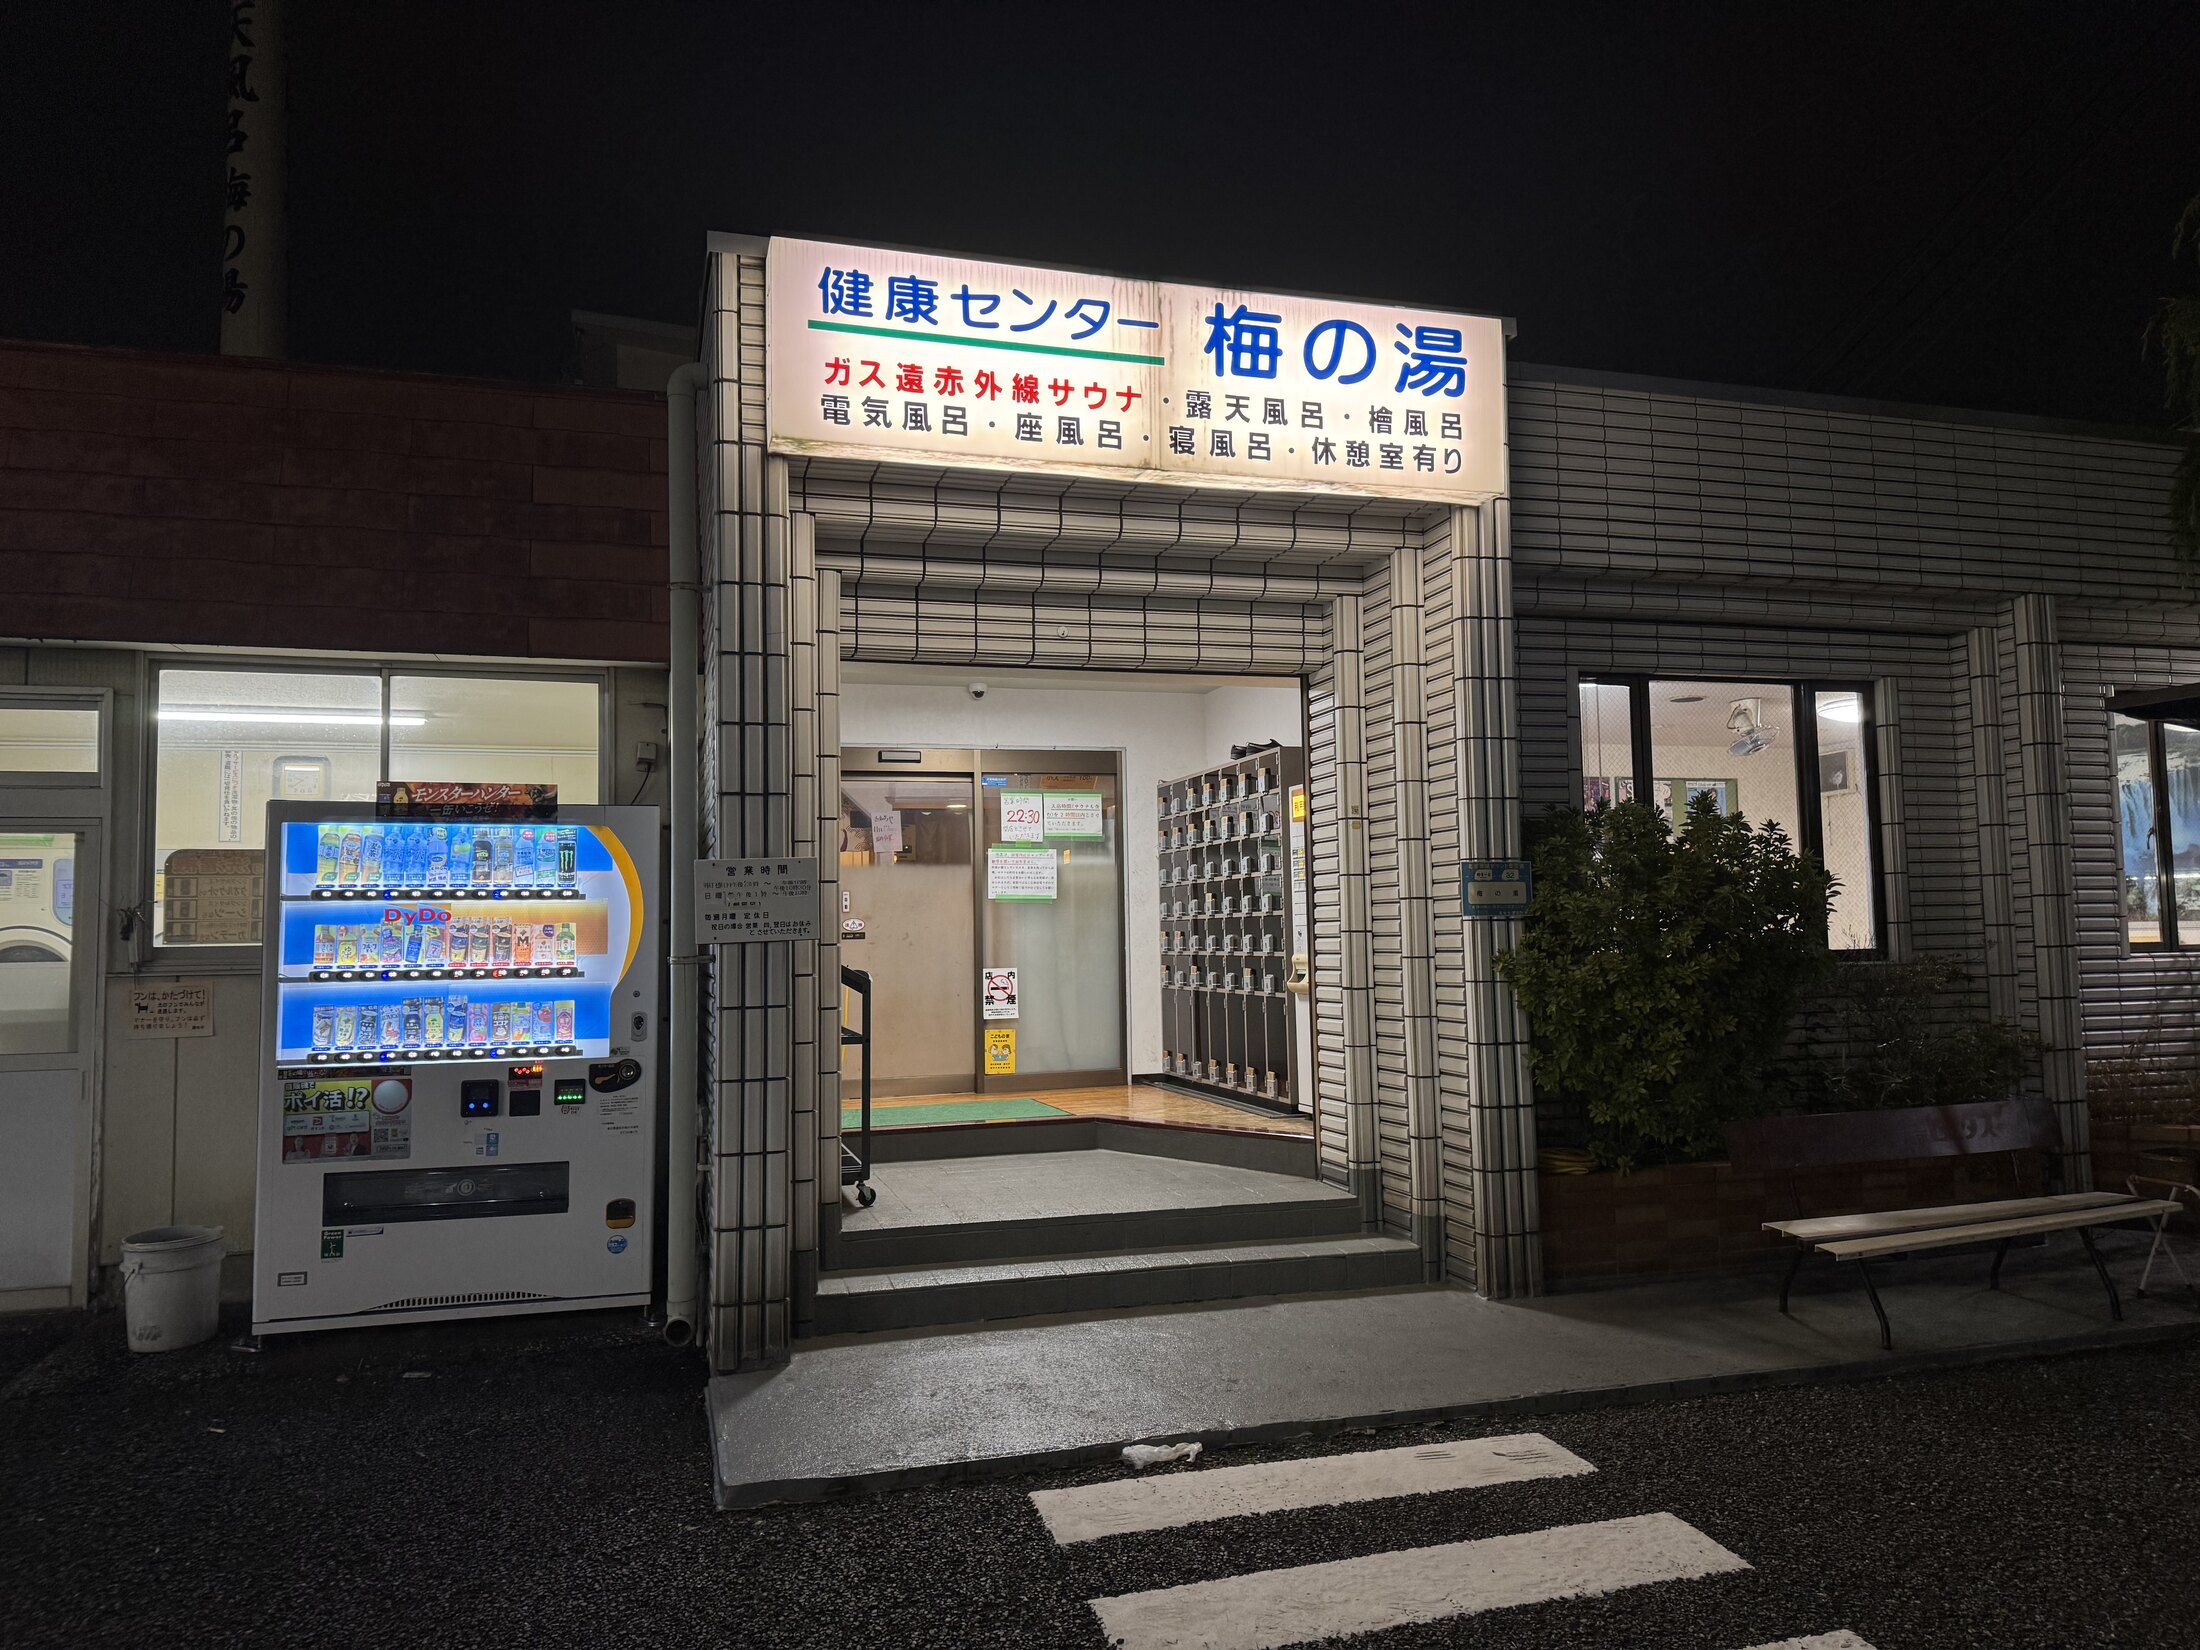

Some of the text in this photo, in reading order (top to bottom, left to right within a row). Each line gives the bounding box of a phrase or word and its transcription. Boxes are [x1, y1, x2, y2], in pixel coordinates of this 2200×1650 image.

[817, 266, 1160, 340] 健康センター
[1203, 303, 1469, 399] 梅の湯
[412, 786, 521, 802] モンスターハンター
[1007, 809, 1040, 824] 22:30
[726, 865, 788, 876] 営業時間
[384, 906, 452, 925] DyDo
[134, 989, 205, 1001] フンは、かたづけて!
